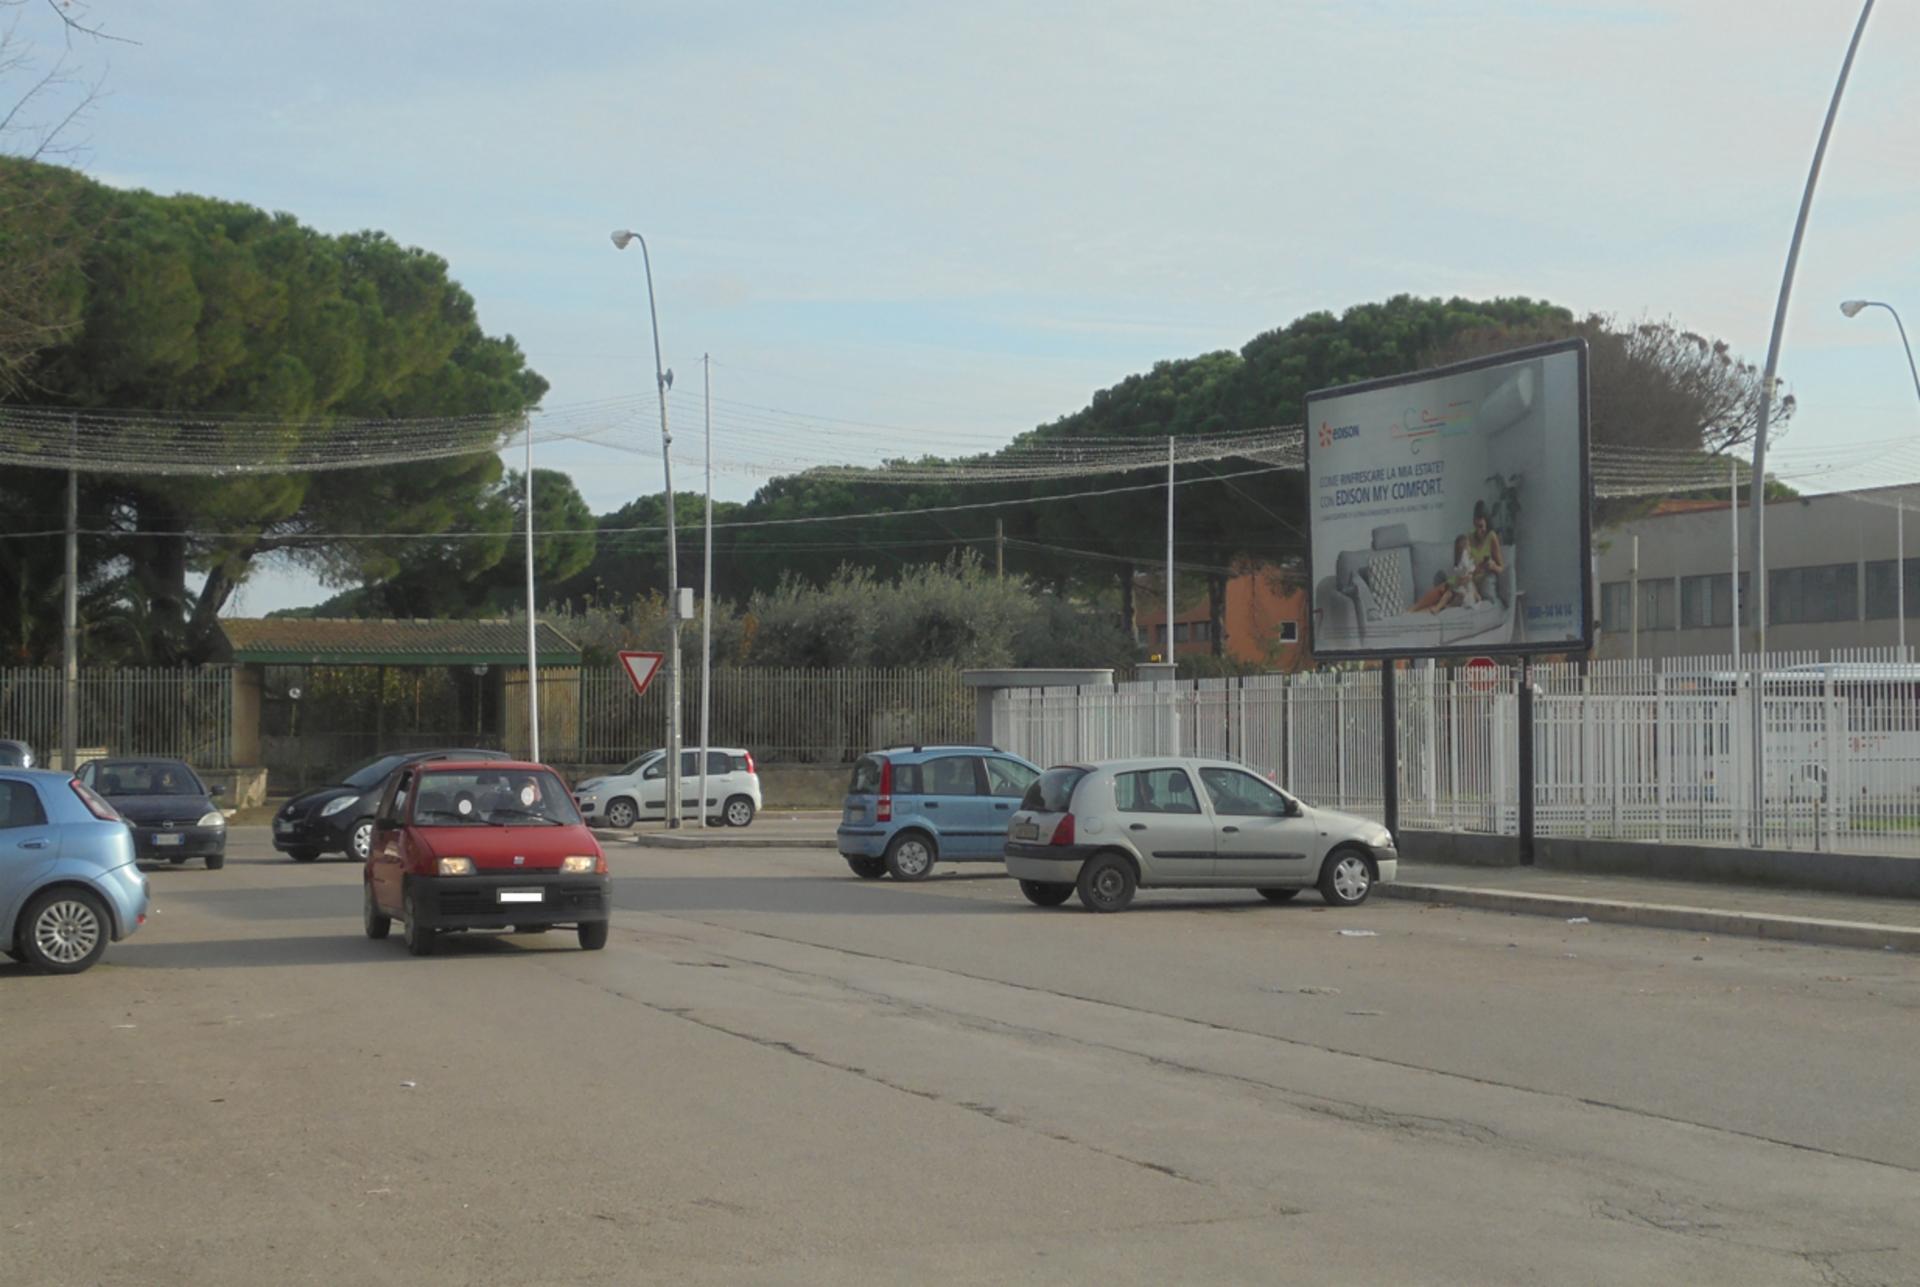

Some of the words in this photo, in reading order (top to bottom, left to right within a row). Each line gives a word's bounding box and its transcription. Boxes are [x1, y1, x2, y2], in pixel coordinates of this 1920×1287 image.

[1333, 425, 1360, 440] EDISON
[1386, 467, 1397, 480] LA
[1398, 465, 1413, 478] MIA
[1335, 488, 1370, 506] EDISON
[1372, 485, 1389, 502] MY
[1392, 477, 1444, 500] COMFORT.
